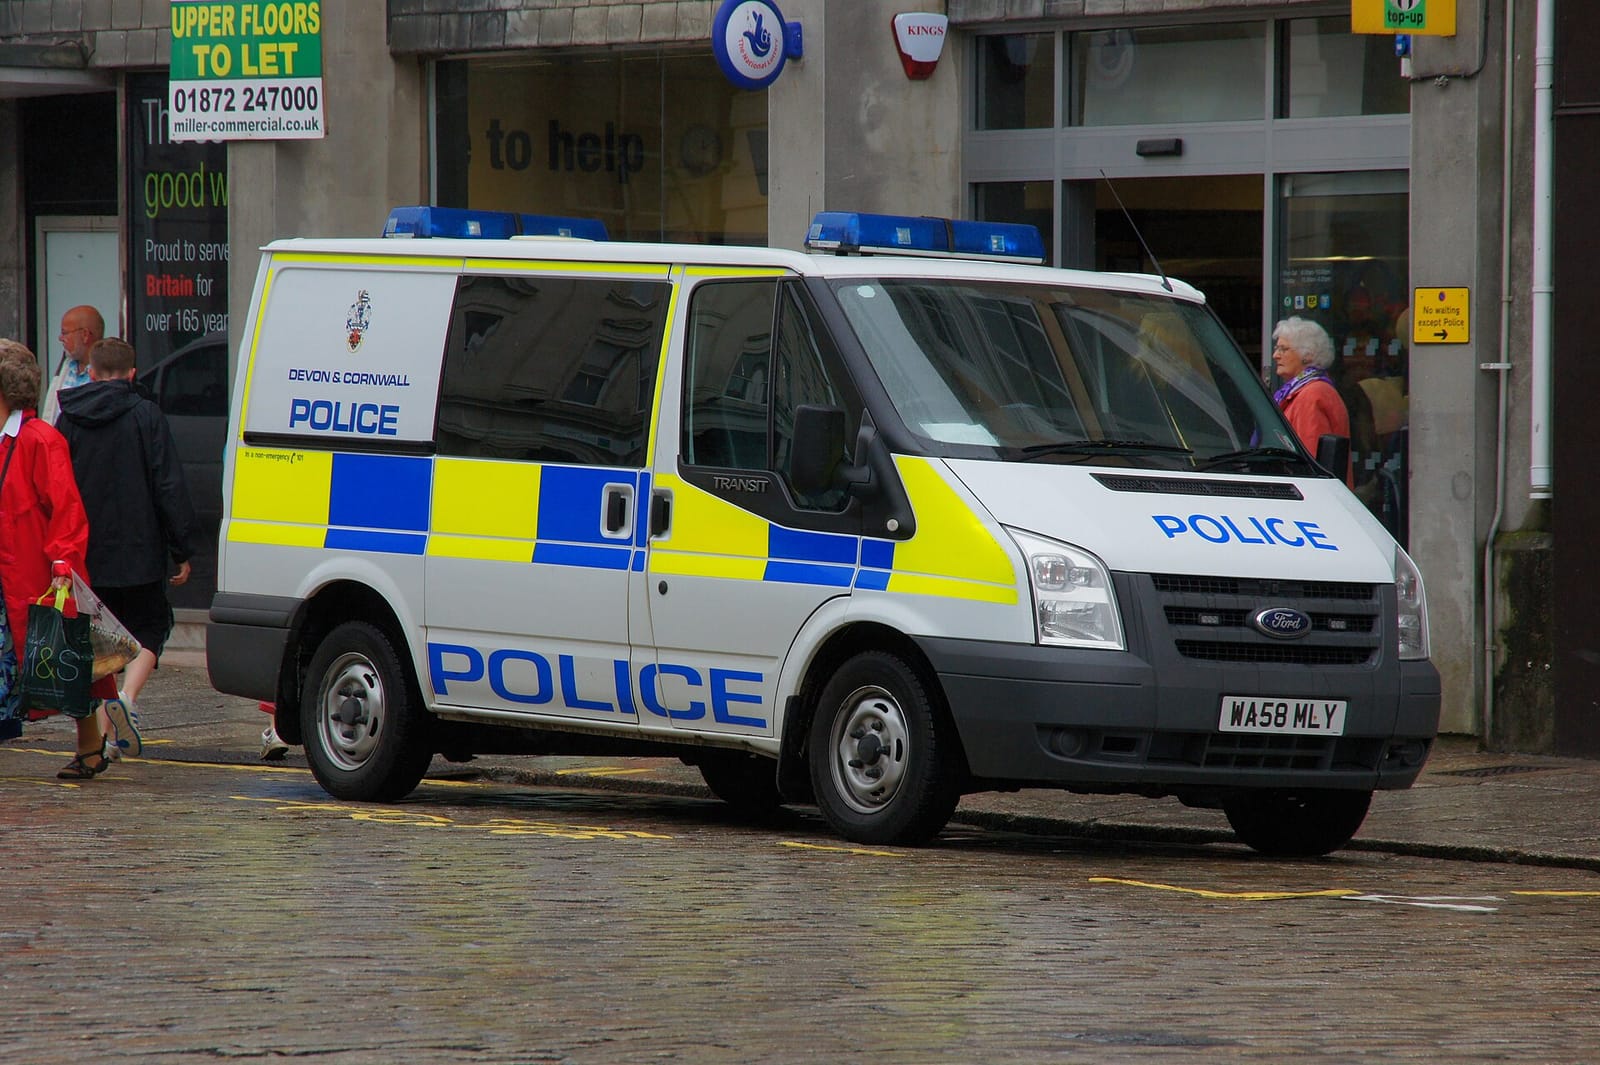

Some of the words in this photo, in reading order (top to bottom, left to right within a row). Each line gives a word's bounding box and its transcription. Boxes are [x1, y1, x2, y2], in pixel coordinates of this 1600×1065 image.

[171, 5, 235, 38] UPPER
[241, 2, 320, 36] FLOORS
[1387, 10, 1424, 26] top-up
[908, 25, 944, 36] KINGS
[192, 45, 232, 77] TO
[241, 42, 298, 76] LET
[174, 88, 236, 113] 01872
[242, 86, 318, 111] 247000
[174, 116, 319, 133] miller-commercial.co.uk
[486, 119, 532, 171] to
[549, 119, 644, 185] help
[144, 161, 205, 219] good
[145, 239, 180, 262] Proud
[184, 241, 196, 262] to
[146, 274, 193, 296] Britain
[197, 274, 213, 297] for
[145, 314, 170, 332] over
[175, 308, 199, 332] 165
[1423, 305, 1433, 314] No
[1435, 305, 1461, 317] waiting
[1418, 319, 1442, 328] except
[1443, 318, 1465, 327] Police
[289, 369, 331, 383] DEVON
[332, 372, 341, 383] &
[343, 372, 410, 386] CORNWALL
[289, 399, 400, 436] POLICE
[713, 476, 769, 493] TRANSIT
[1152, 514, 1339, 551] POLICE
[1272, 612, 1301, 629] Ford
[427, 642, 767, 729] POLICE
[1230, 701, 1289, 728] WA58
[1292, 703, 1338, 729] MLY
